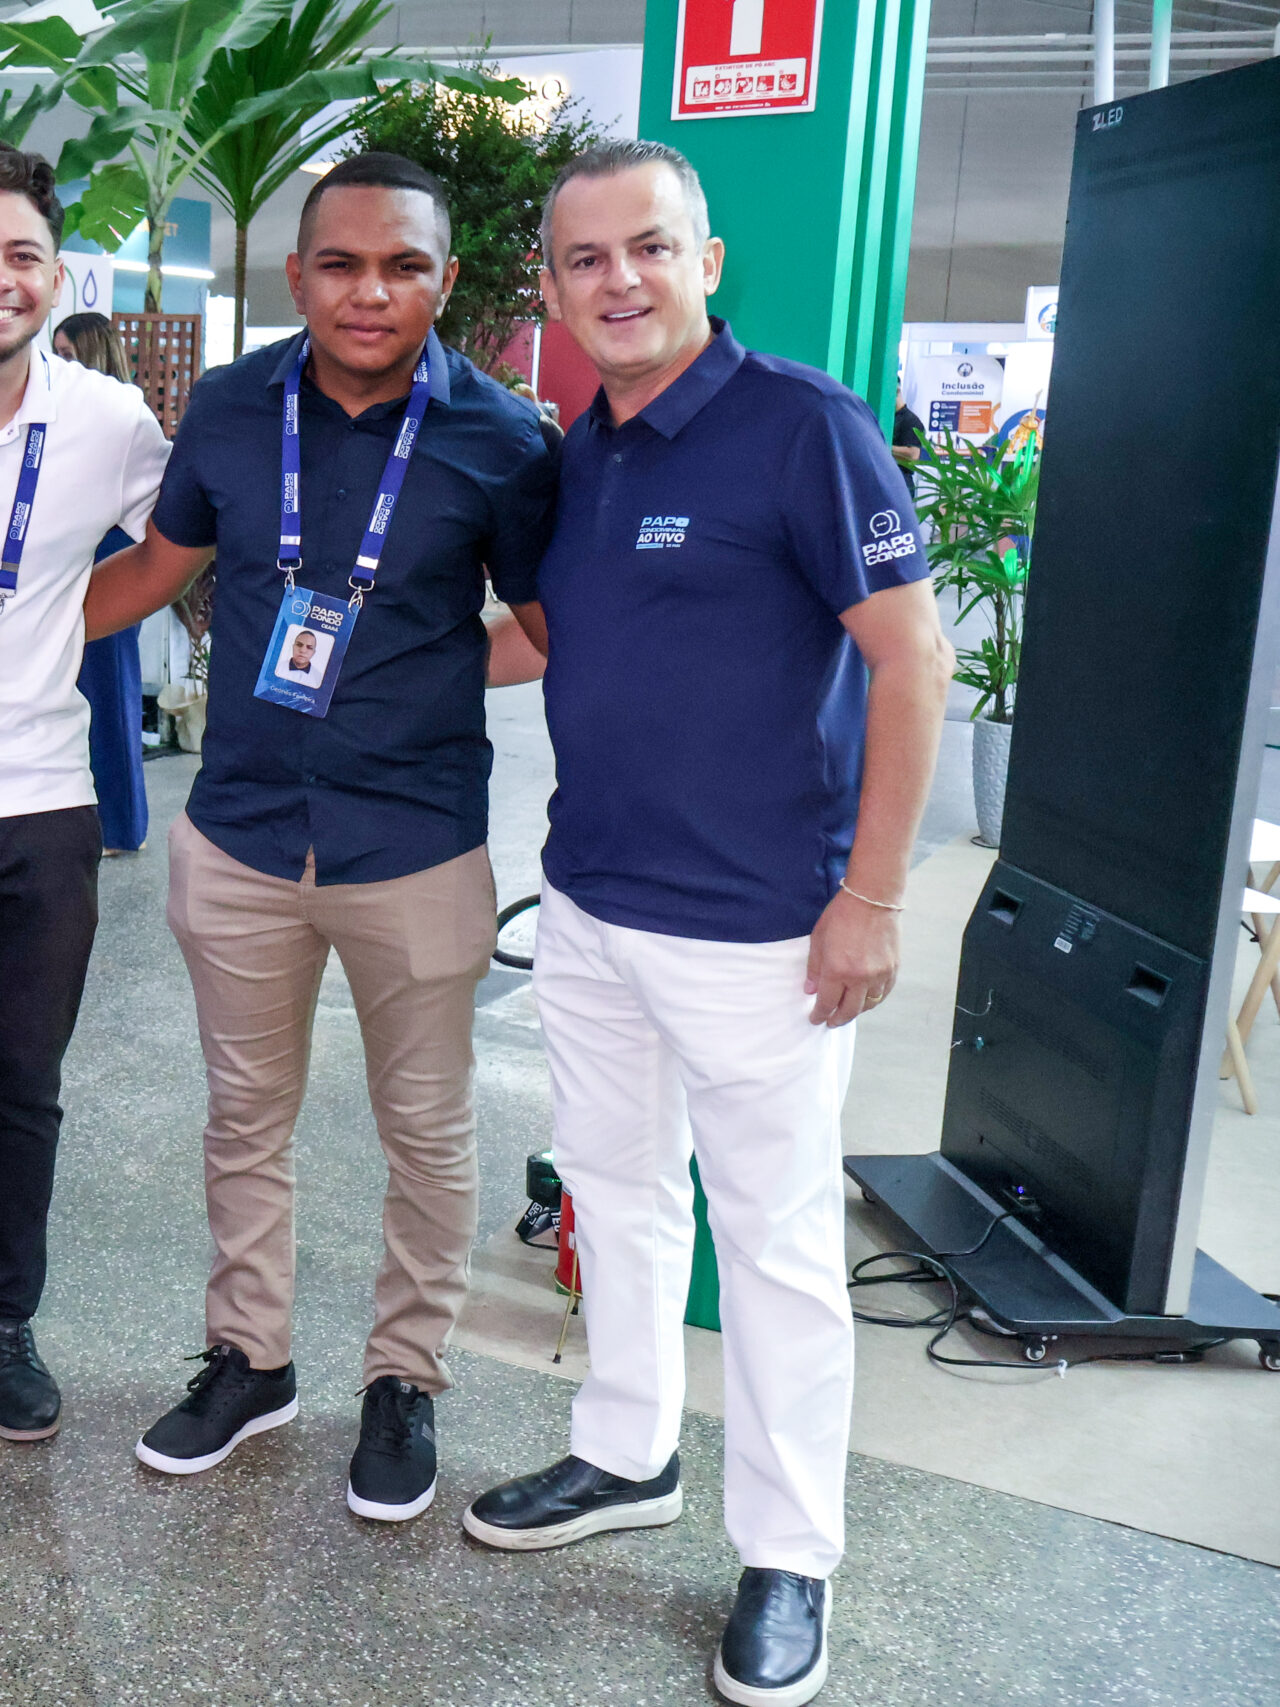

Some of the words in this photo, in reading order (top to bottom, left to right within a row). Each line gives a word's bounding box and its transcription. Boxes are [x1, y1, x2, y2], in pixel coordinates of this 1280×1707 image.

[941, 382, 985, 390] Inclusão
[28, 429, 37, 455] PAPO
[404, 432, 414, 459] PAPO
[12, 502, 23, 527] PAPO
[378, 508, 391, 535] PAPO
[637, 533, 653, 543] AO
[654, 532, 685, 543] VIVO
[862, 532, 914, 557] PAPO
[865, 544, 916, 566] CONDO
[310, 613, 342, 627] CONDO
[311, 605, 344, 620] PAPO
